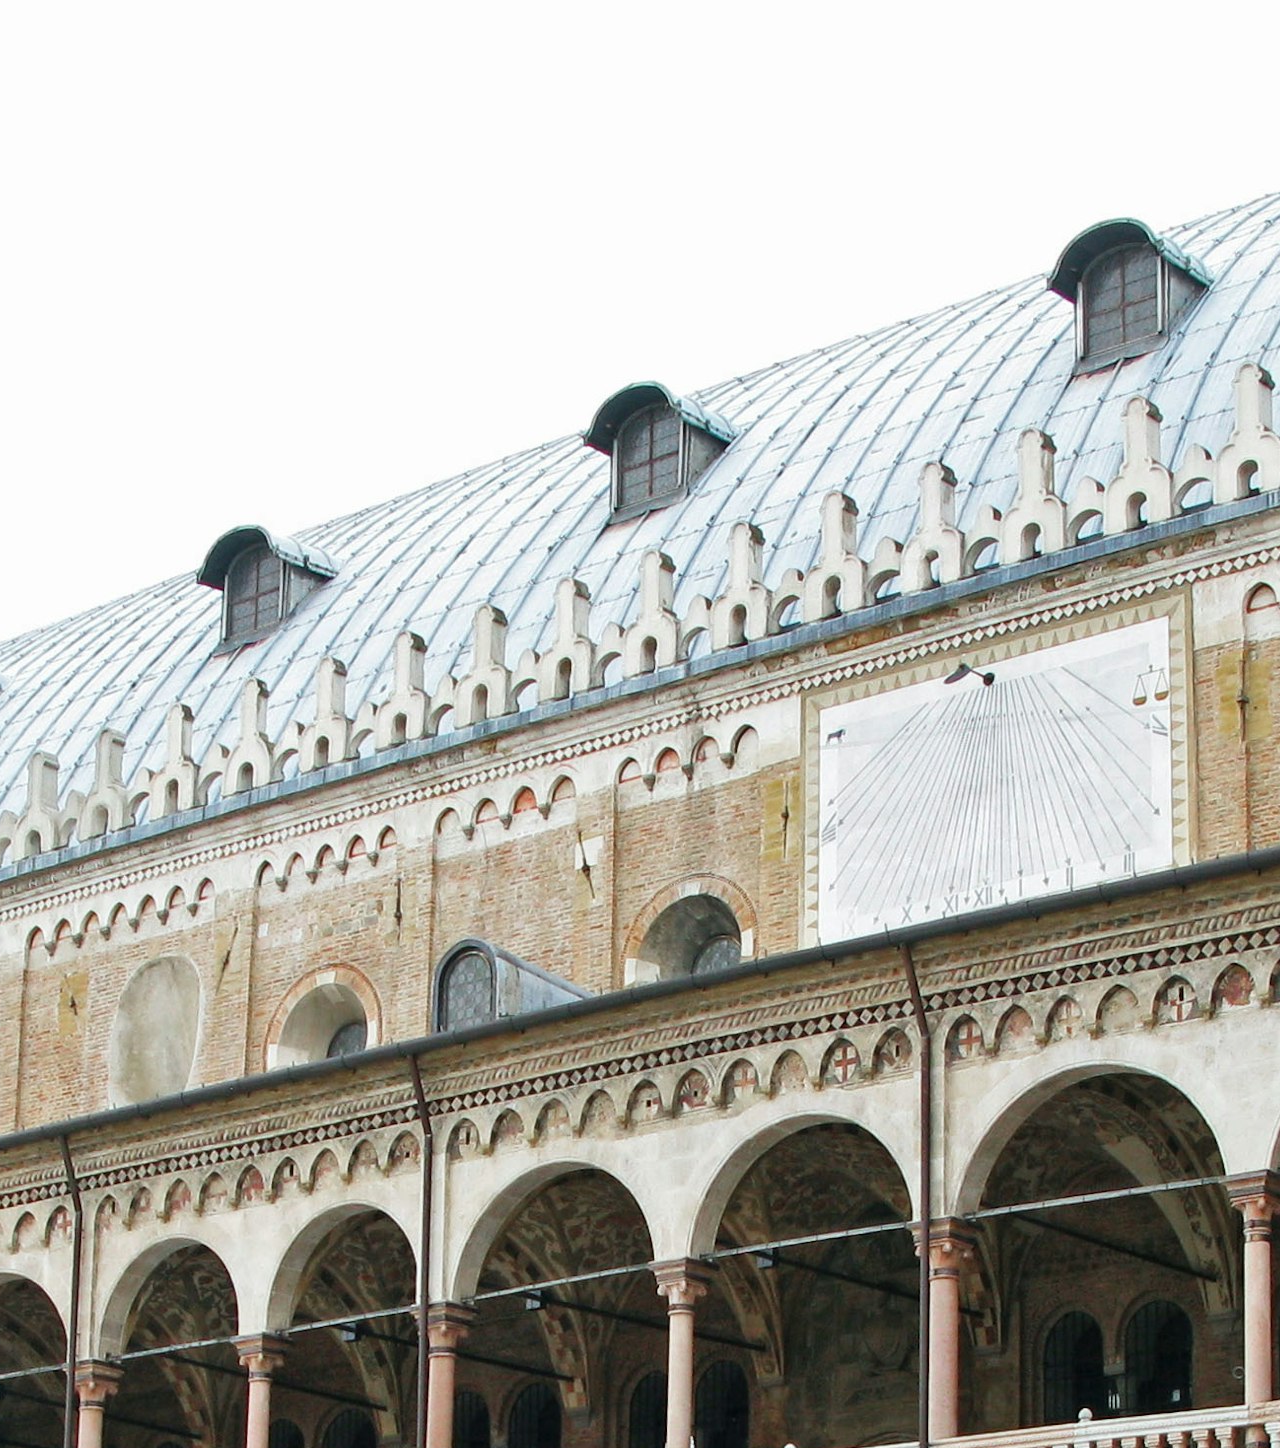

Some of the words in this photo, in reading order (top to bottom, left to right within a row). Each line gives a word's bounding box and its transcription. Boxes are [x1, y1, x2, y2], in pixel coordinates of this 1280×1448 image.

[944, 894, 959, 914] XI
[975, 886, 993, 908] XII
[901, 904, 913, 924] X
